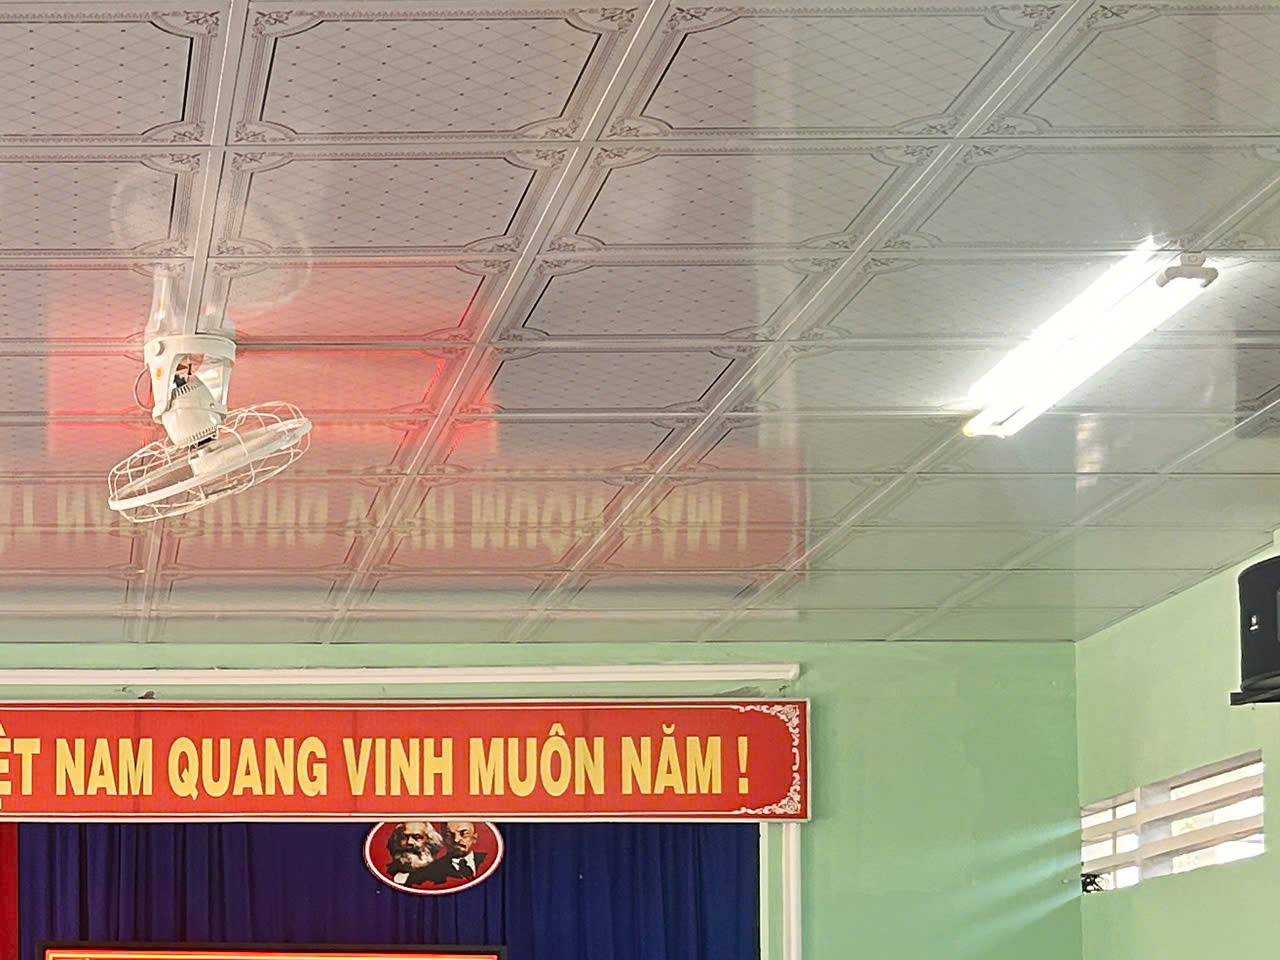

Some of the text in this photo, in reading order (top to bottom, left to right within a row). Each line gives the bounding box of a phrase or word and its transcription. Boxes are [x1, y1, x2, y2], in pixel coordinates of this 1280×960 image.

[56, 737, 153, 797] NAM
[167, 736, 327, 801] QUANG
[343, 737, 454, 797] VINH
[469, 722, 606, 798] MUÔN
[621, 723, 722, 796] NĂM
[738, 736, 749, 795] !
